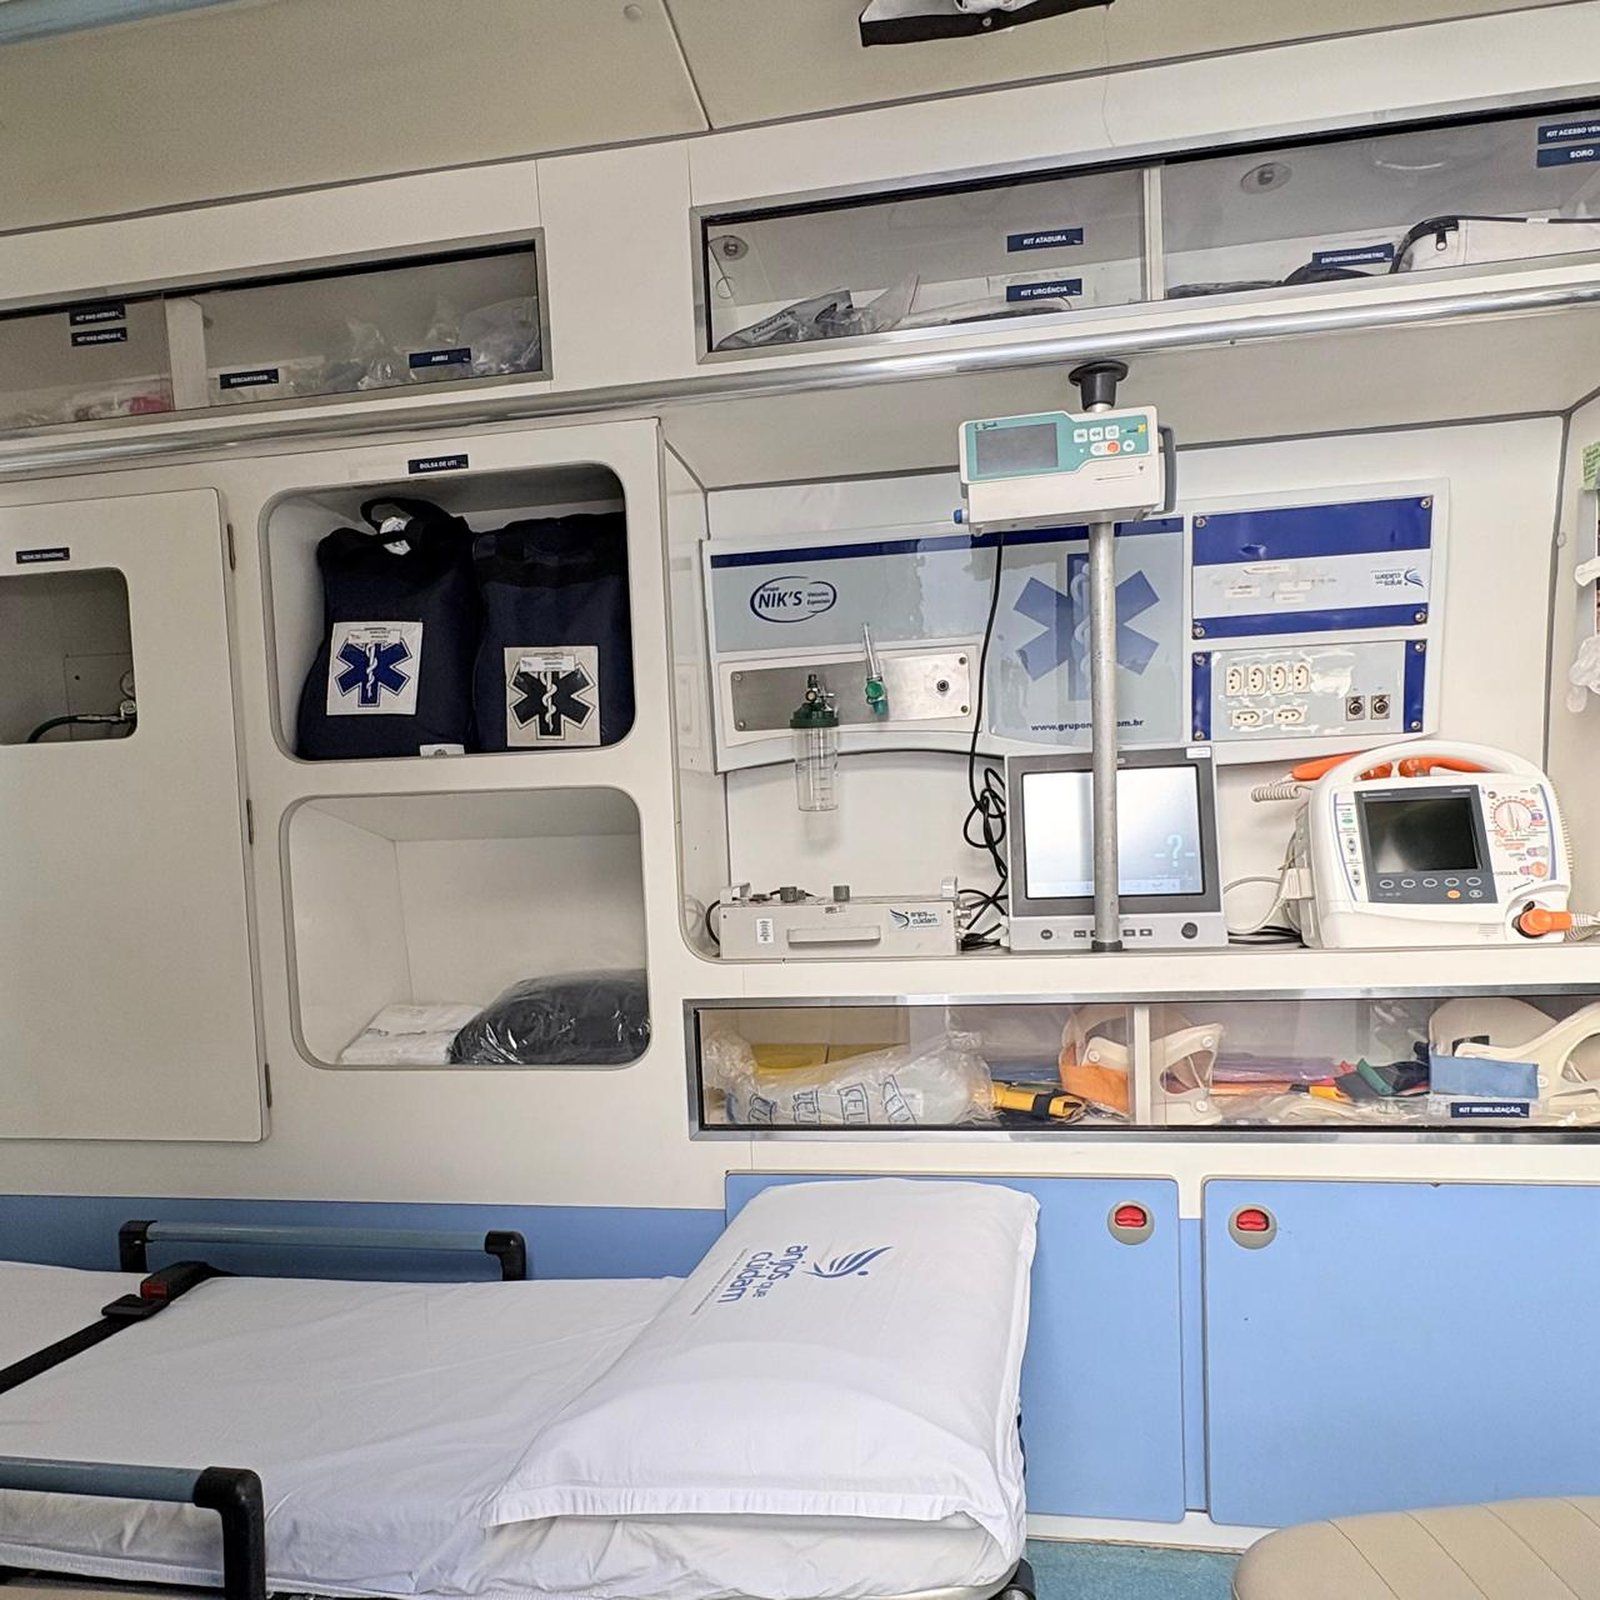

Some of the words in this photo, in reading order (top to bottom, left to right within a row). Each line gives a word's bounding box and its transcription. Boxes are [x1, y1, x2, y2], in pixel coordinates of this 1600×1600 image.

[1546, 129, 1558, 138] KIT
[1558, 127, 1587, 136] ACESSO
[1569, 149, 1594, 159] SORO
[1023, 237, 1035, 246] KIT
[1035, 234, 1067, 244] ATADURA
[1020, 289, 1032, 297] KIT
[1032, 286, 1068, 296] URGÊNCIA
[758, 591, 803, 609] NIK'S
[1458, 1106, 1470, 1114] KIT
[766, 1245, 808, 1281] anjos
[717, 1251, 773, 1303] cuidam
